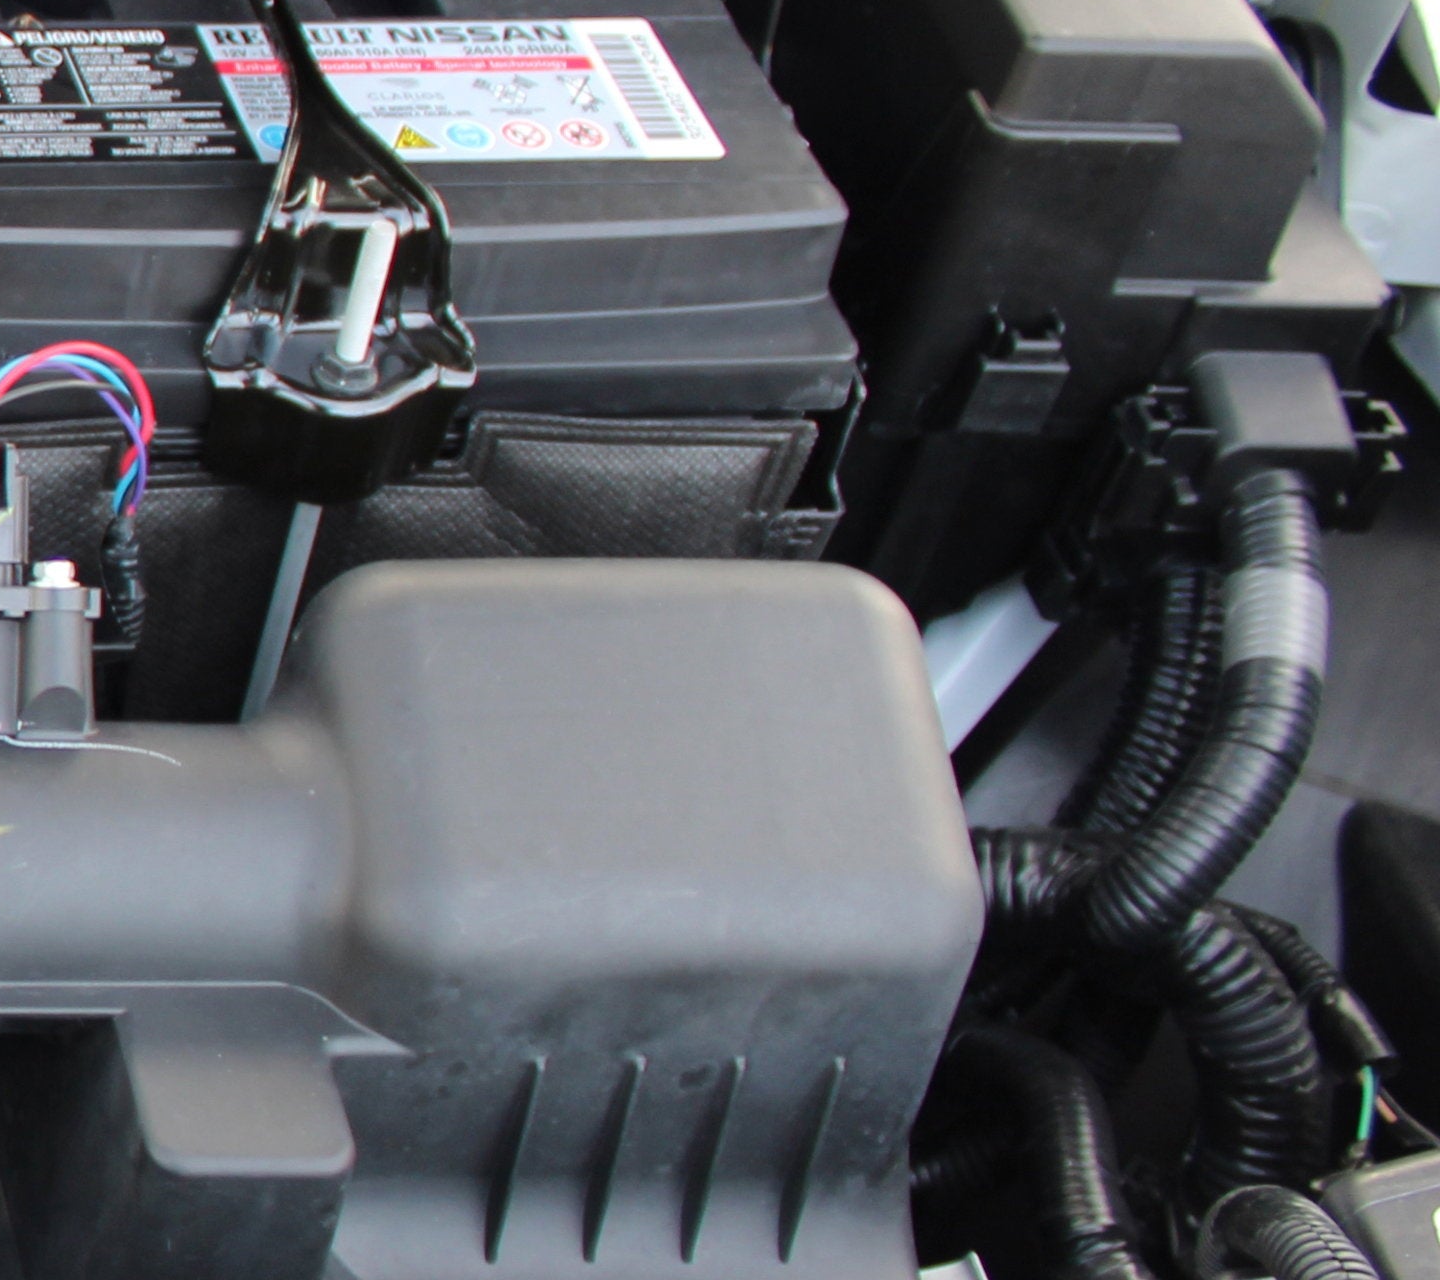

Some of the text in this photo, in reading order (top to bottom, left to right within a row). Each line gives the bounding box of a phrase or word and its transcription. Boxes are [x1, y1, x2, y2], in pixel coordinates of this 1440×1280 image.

[13, 29, 166, 46] PELIGRO/VENENO
[211, 24, 571, 45] REULT NISSAN
[370, 60, 423, 72] Battery
[434, 59, 487, 71] Special
[489, 58, 568, 72] technology
